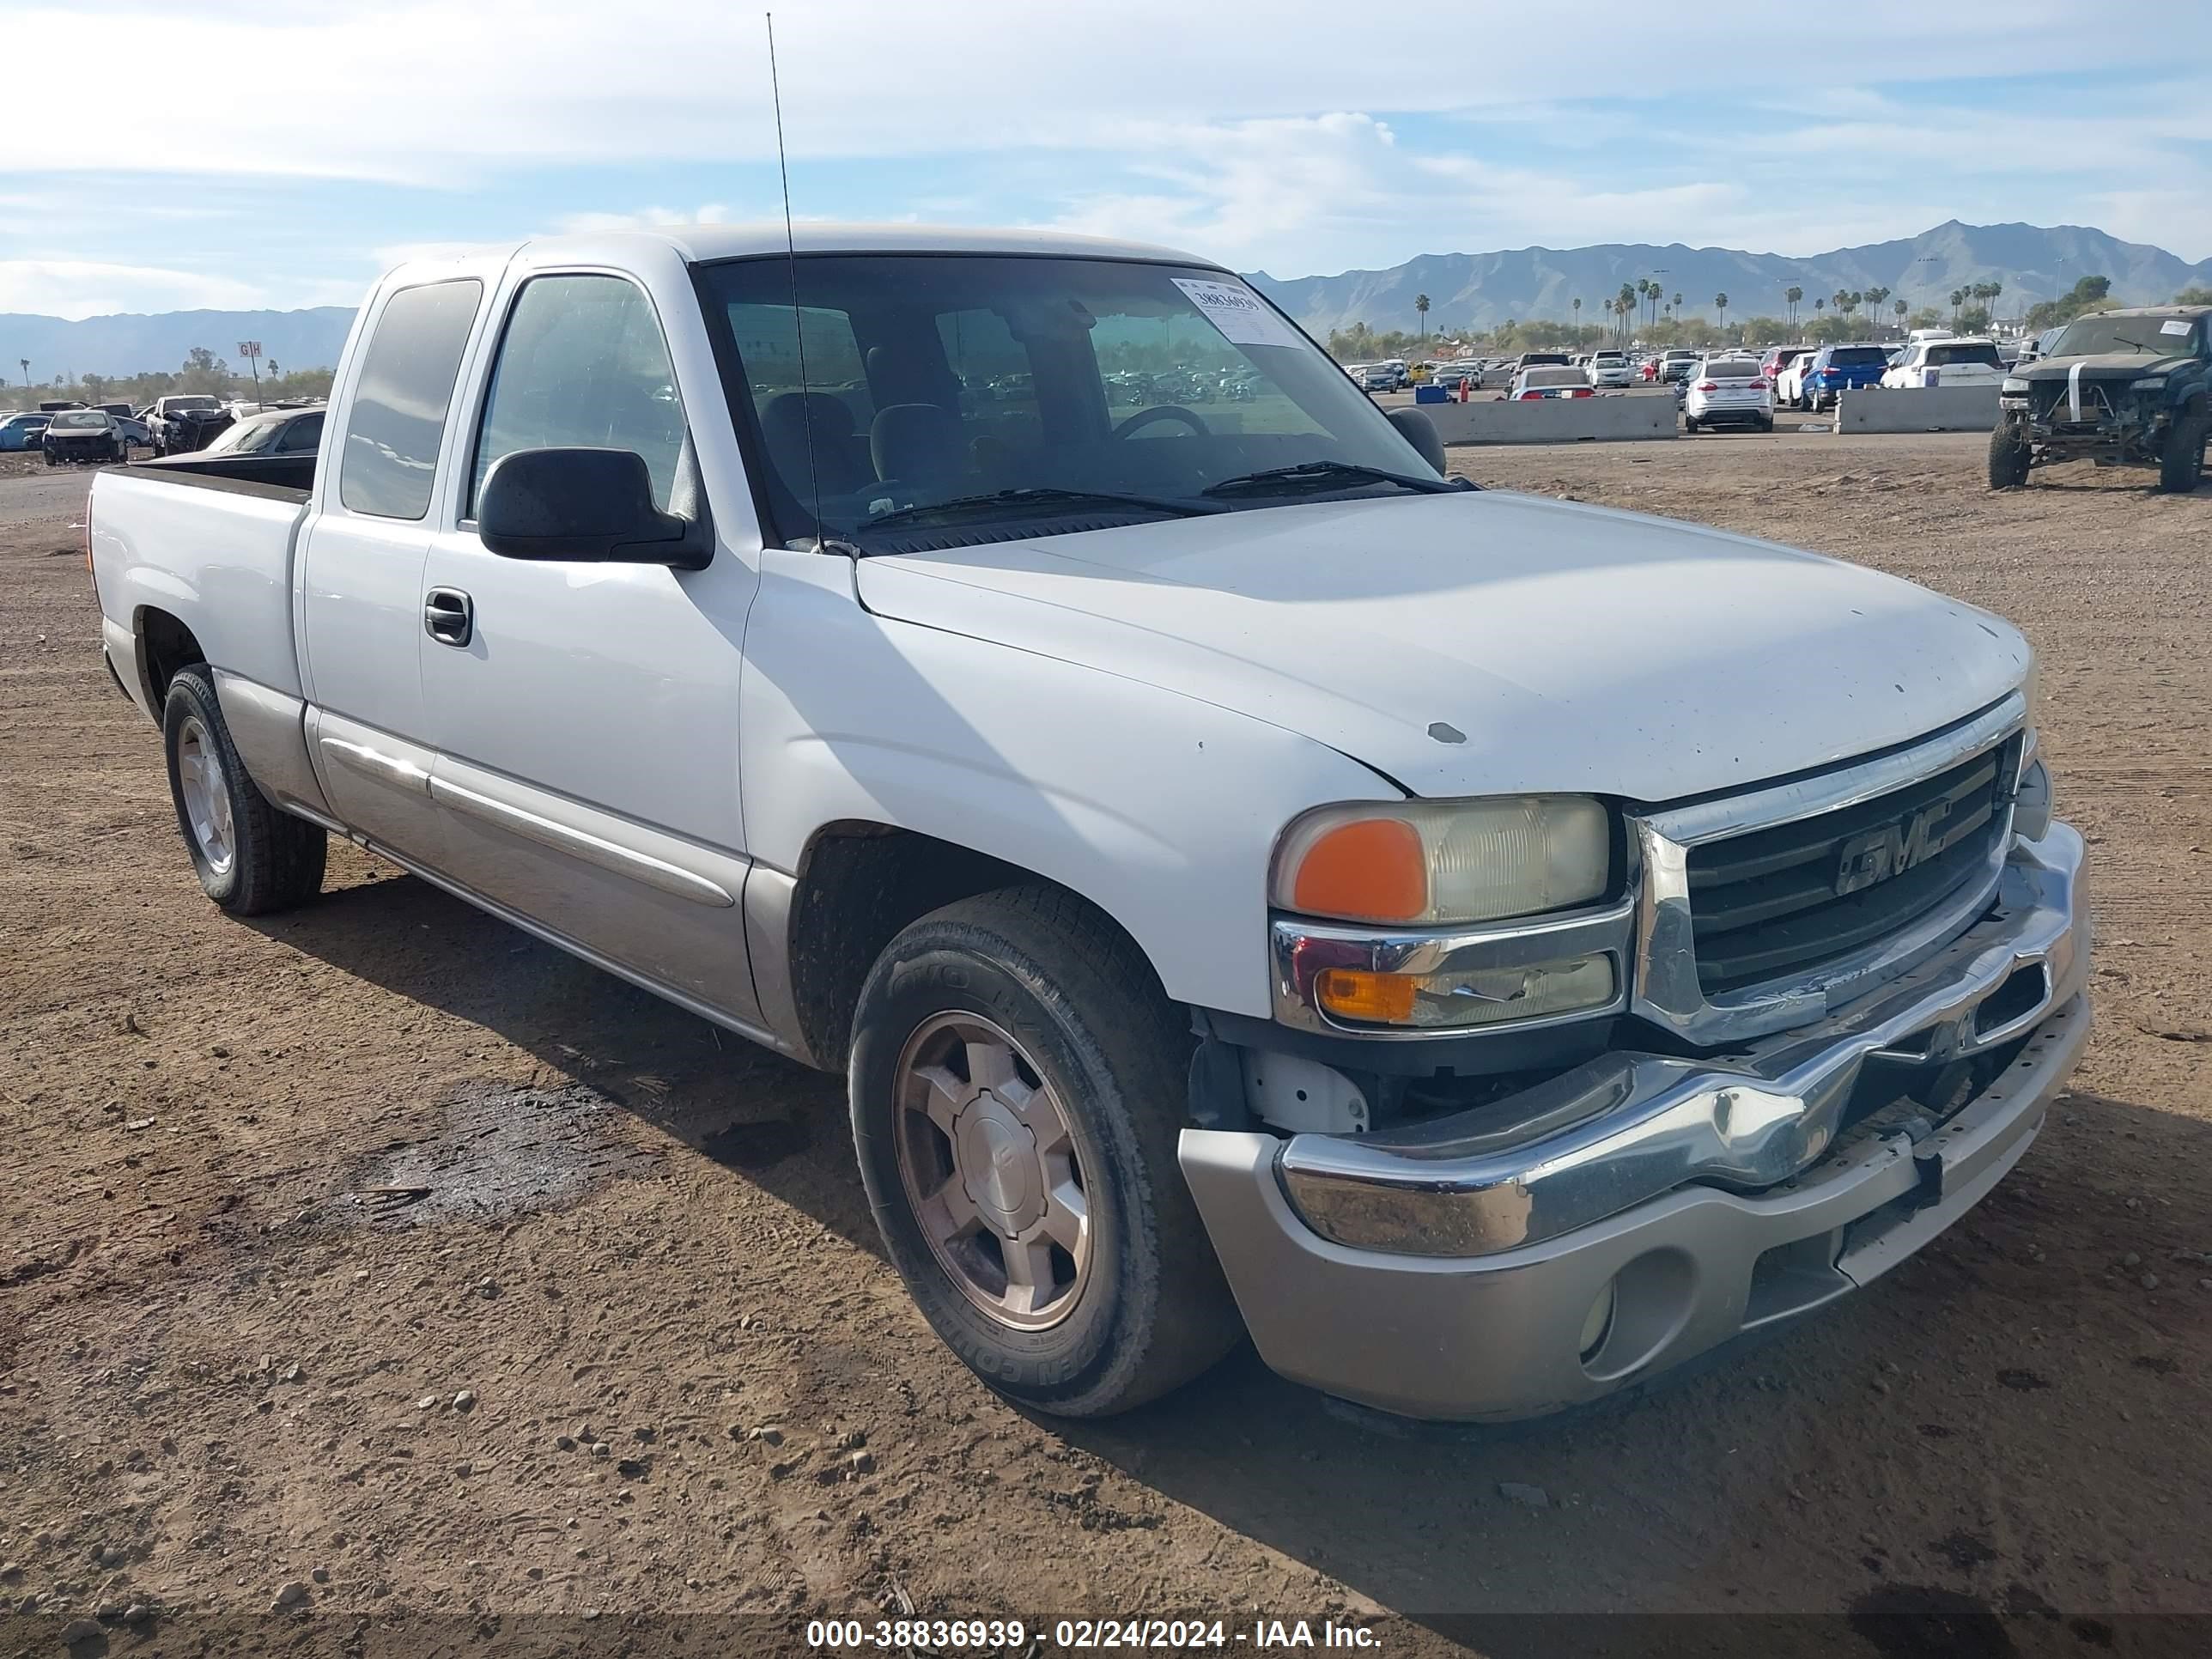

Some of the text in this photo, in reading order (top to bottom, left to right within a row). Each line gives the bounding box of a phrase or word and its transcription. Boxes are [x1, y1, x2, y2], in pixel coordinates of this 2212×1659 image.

[1194, 292, 1259, 310] 38836939
[240, 343, 260, 356] G H
[1836, 801, 1952, 896] GMC
